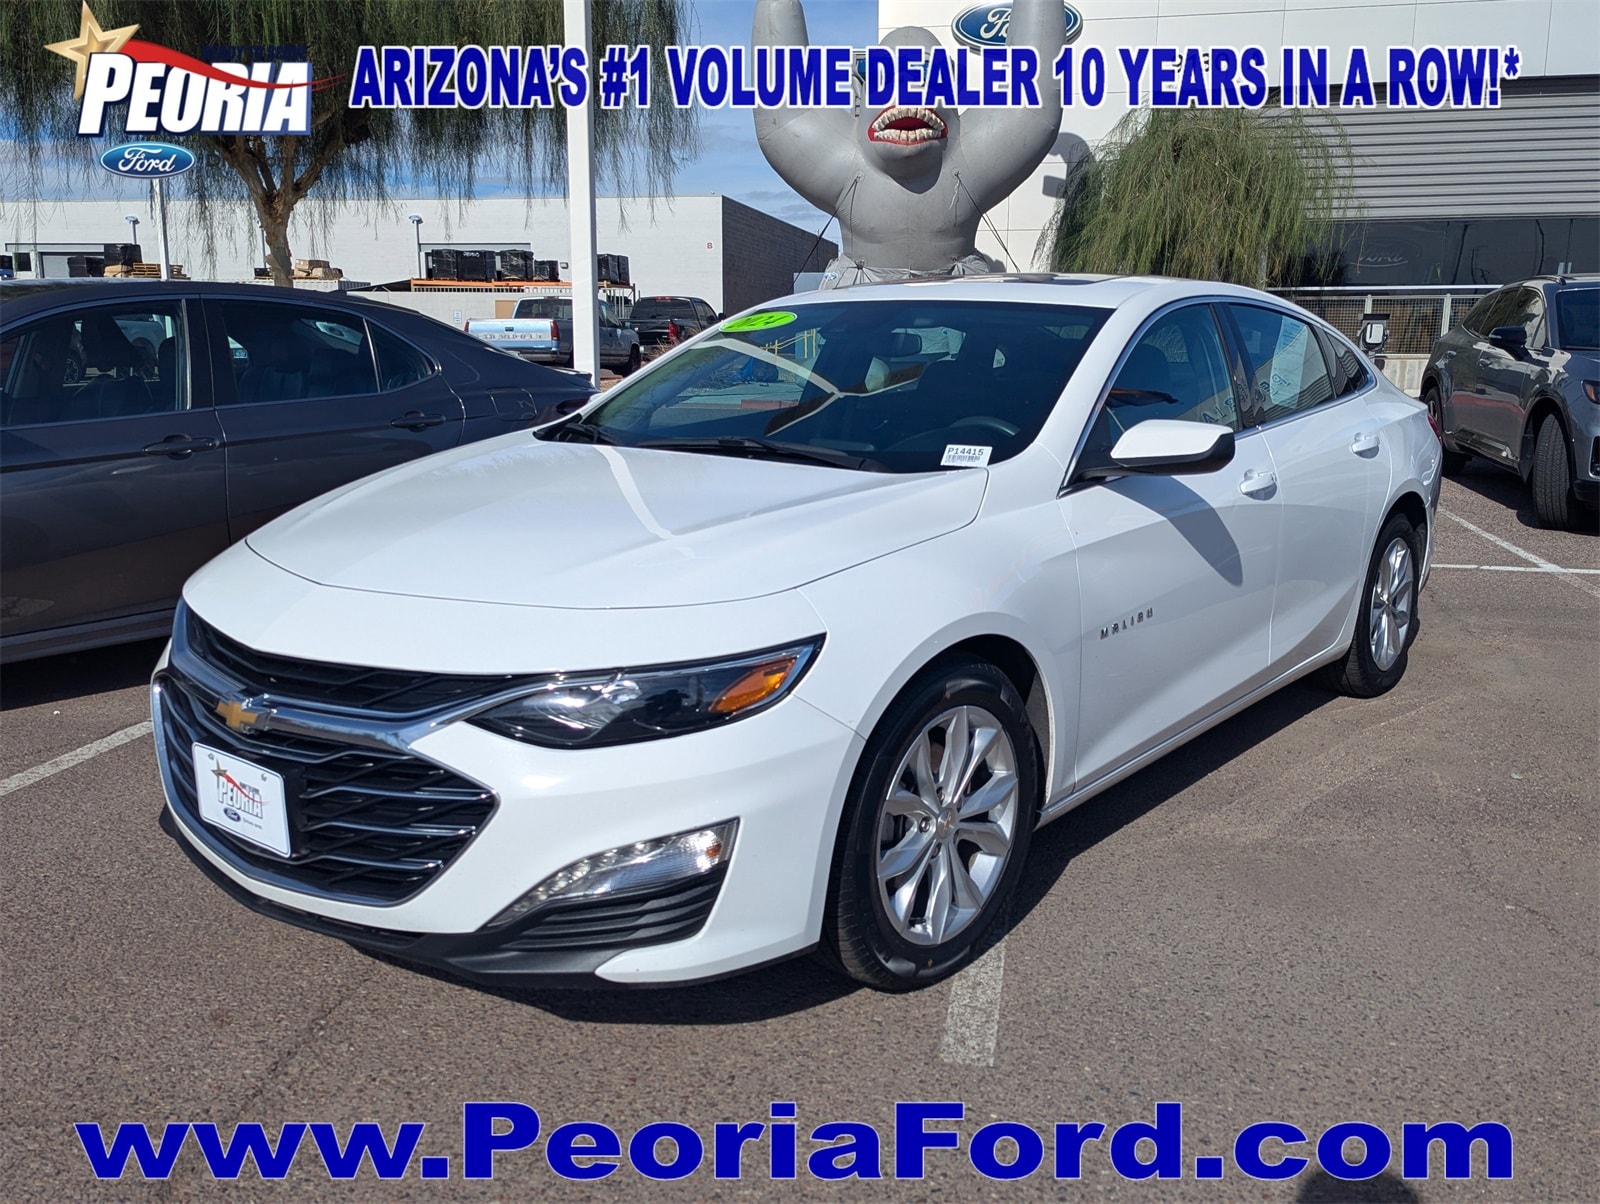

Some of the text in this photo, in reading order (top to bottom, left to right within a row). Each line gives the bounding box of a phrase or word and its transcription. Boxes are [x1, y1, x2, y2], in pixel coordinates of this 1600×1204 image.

[947, 447, 985, 456] P14415
[1100, 607, 1153, 640] MALIBU
[217, 776, 263, 820] PEORIA
